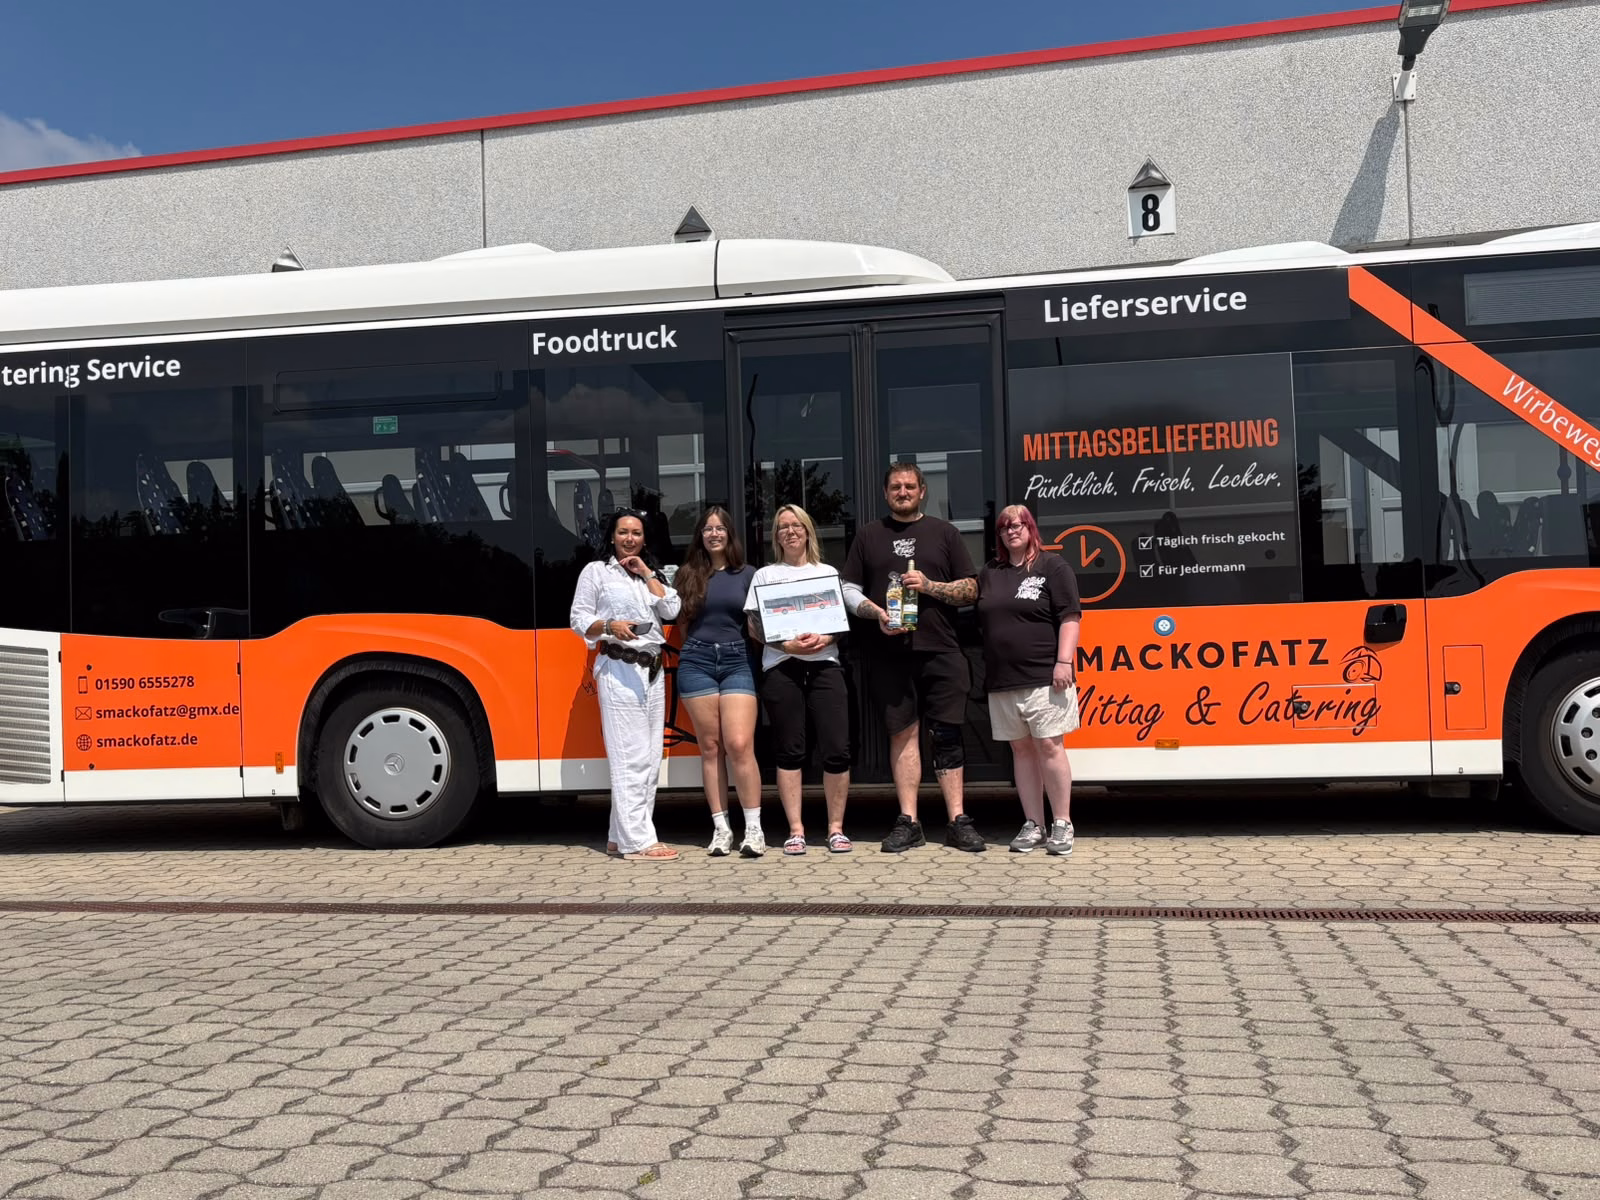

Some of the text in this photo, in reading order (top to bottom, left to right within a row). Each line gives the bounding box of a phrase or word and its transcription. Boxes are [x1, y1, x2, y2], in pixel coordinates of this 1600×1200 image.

[1141, 193, 1161, 232] 8
[1044, 287, 1248, 323] Lieferservice
[532, 324, 678, 356] Foodtruck
[1, 355, 182, 389] tering Service
[1023, 418, 1280, 462] MITTAGSBELIEFERUNG
[1024, 461, 1282, 501] Pünktlich. Frisch. Lecker.
[1157, 531, 1286, 549] Täglich frisch gekocht
[1158, 563, 1246, 577] Für Jedermann
[95, 675, 195, 691] 01590 6555278
[95, 702, 240, 720] smackofatz@gmx.de
[1184, 685, 1222, 726] &
[96, 733, 198, 748] smackofatz.de
